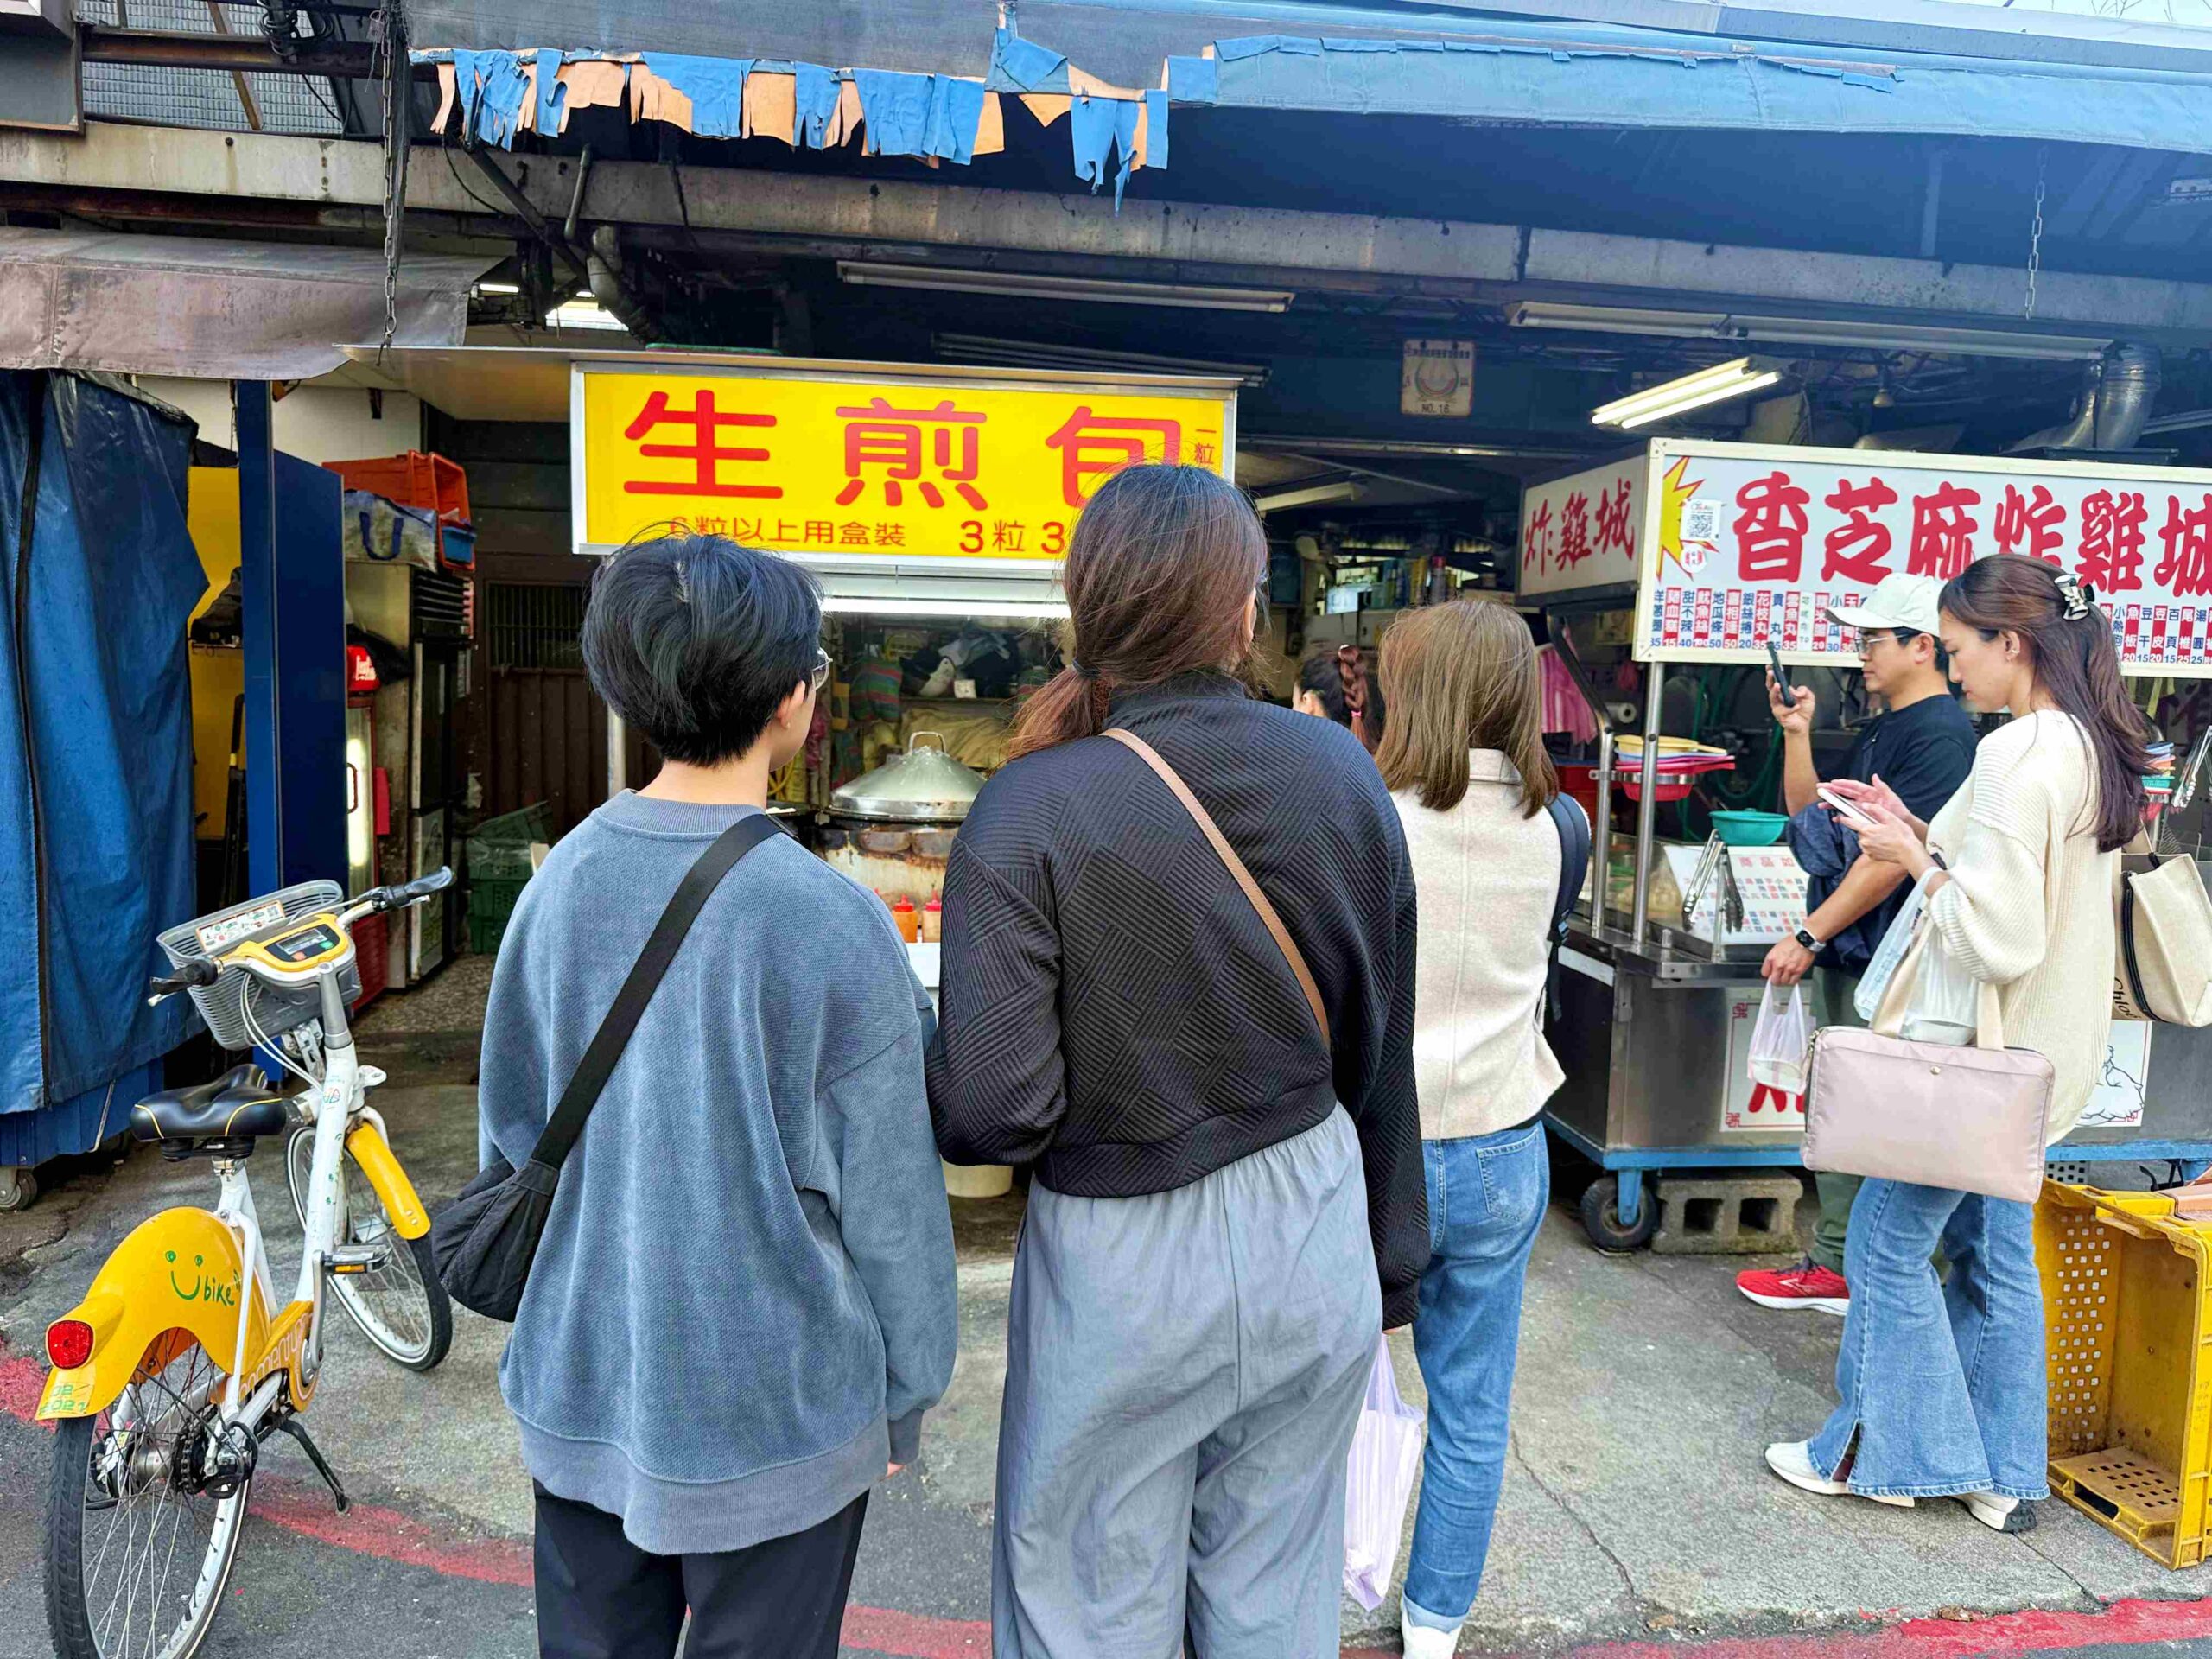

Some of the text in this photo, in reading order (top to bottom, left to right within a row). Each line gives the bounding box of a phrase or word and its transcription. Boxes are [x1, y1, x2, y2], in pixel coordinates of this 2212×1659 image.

[624, 390, 1180, 511] 生煎包
[1524, 478, 1635, 578] 炸雞城
[1732, 471, 2212, 597] 香芝麻炸雞城
[1681, 591, 1694, 632] 甜不辣
[1709, 592, 1725, 649] 地瓜條 50
[1753, 592, 1770, 650] 花枝丸 35
[1770, 594, 1783, 634] 貢丸
[1827, 596, 1842, 652] 小瓜 30
[2124, 607, 2139, 662] 魚板 20
[2138, 607, 2152, 663] 豆干 15
[2151, 607, 2167, 663] 豆皮 20
[2165, 609, 2180, 664] 百頁 15
[2191, 609, 2206, 664] 湯圓 25
[1724, 640, 1737, 649] 50
[1739, 640, 1751, 649] 20
[1783, 642, 1796, 651] 35
[1813, 642, 1826, 651] 20
[2178, 655, 2190, 664] 25
